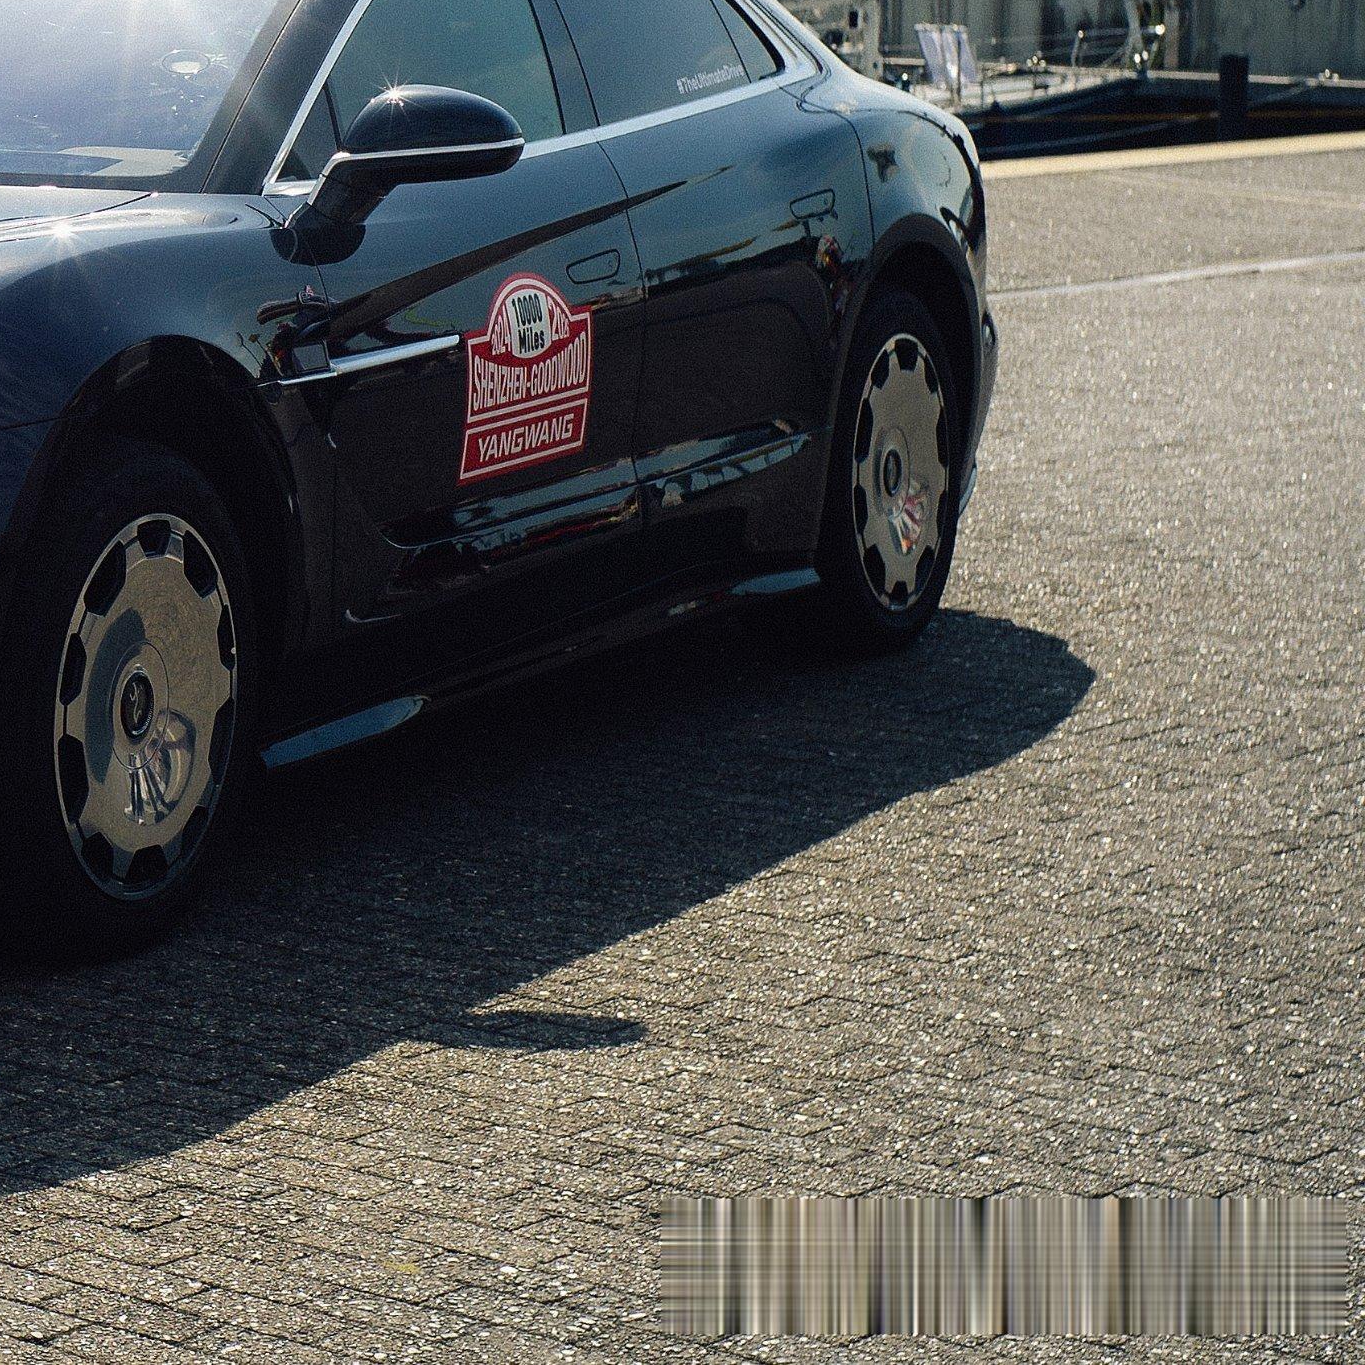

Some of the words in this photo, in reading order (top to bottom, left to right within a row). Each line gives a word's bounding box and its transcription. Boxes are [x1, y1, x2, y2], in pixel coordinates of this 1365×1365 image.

[491, 304, 511, 356] 2024
[511, 292, 544, 328] 10000
[517, 326, 545, 354] Miles
[473, 331, 587, 411] SHENZHEN-GOODWOOD
[477, 413, 575, 463] YANGWANG
